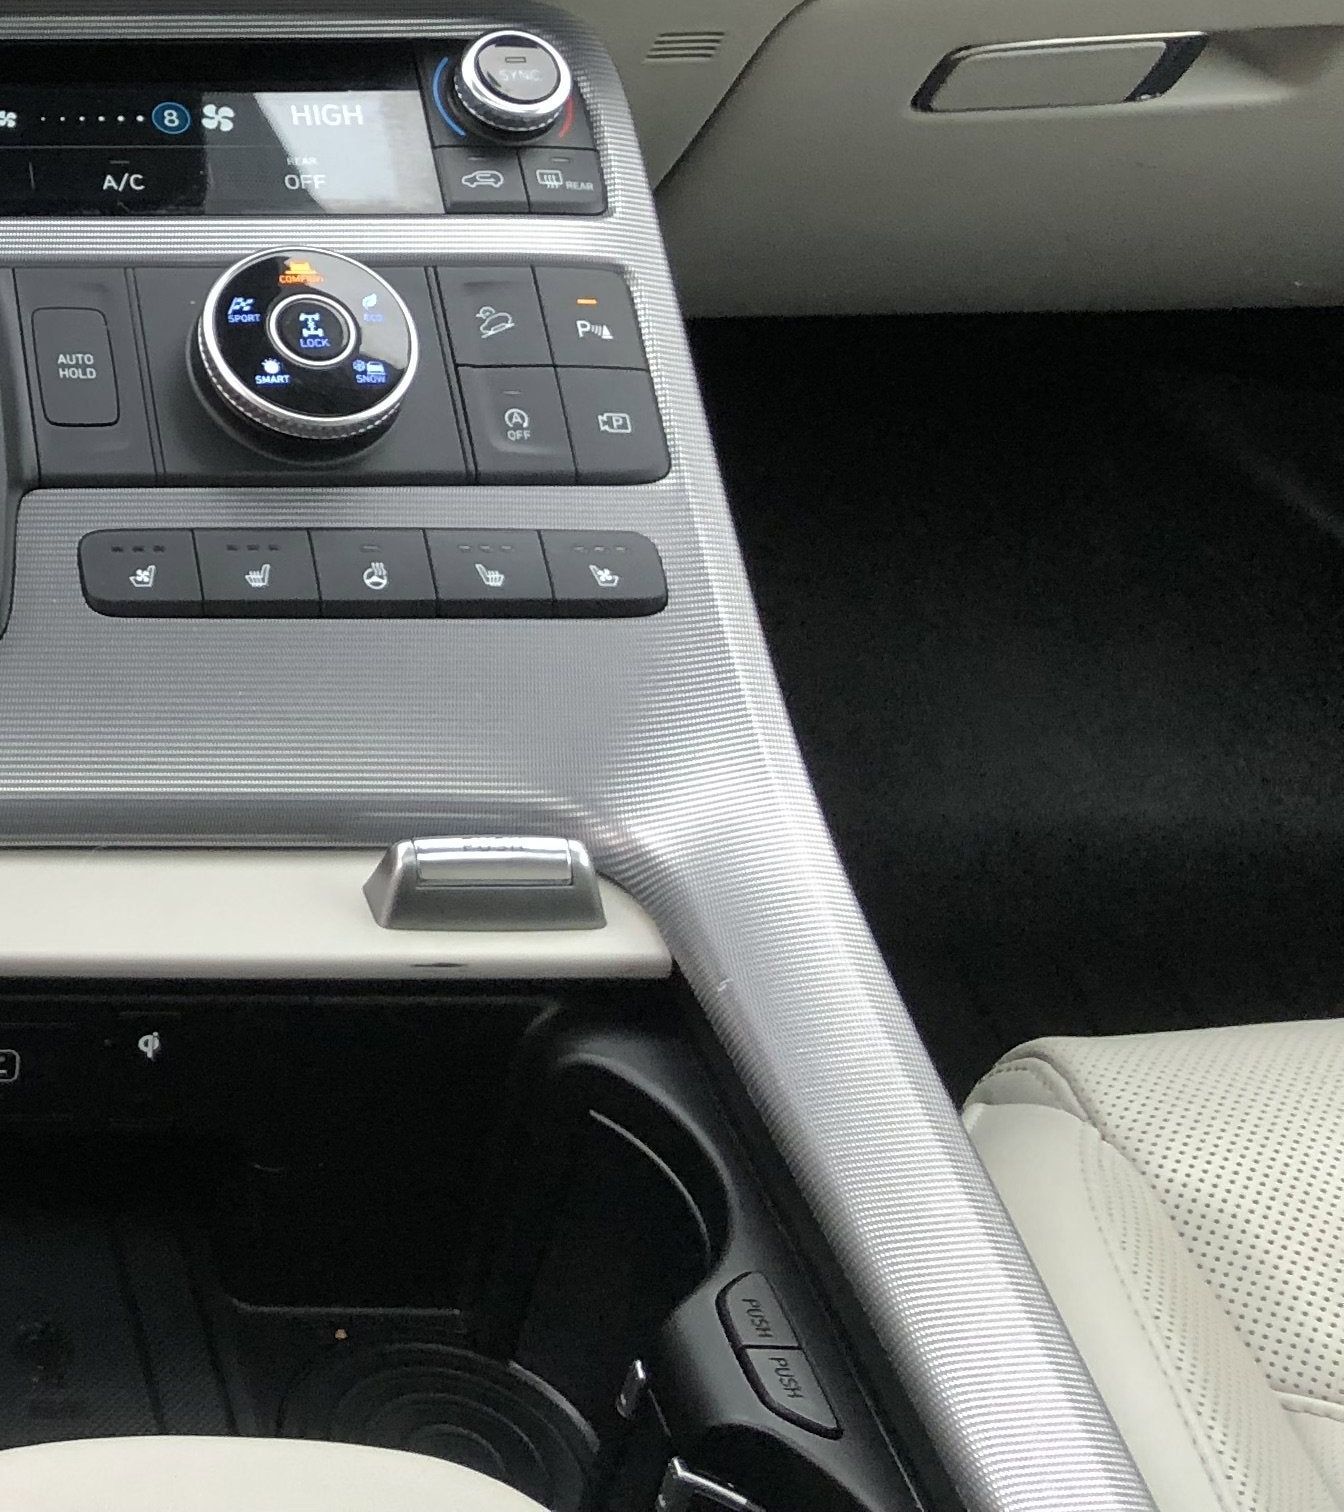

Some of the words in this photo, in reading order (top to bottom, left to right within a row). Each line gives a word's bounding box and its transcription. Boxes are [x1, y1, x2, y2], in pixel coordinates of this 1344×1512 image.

[162, 109, 180, 127] 8
[290, 103, 364, 127] HIGH
[102, 173, 146, 192] A/C
[284, 174, 326, 190] OFF
[565, 180, 594, 191] REAR
[227, 313, 261, 323] SPORT
[300, 338, 330, 349] LOCK
[57, 353, 94, 365] AUTO
[58, 367, 97, 379] HOLD
[254, 374, 290, 384] SMART
[355, 374, 387, 384] SNOW
[507, 429, 531, 441] OFF
[741, 1297, 774, 1338] PUSH
[768, 1356, 804, 1398] PUSH
